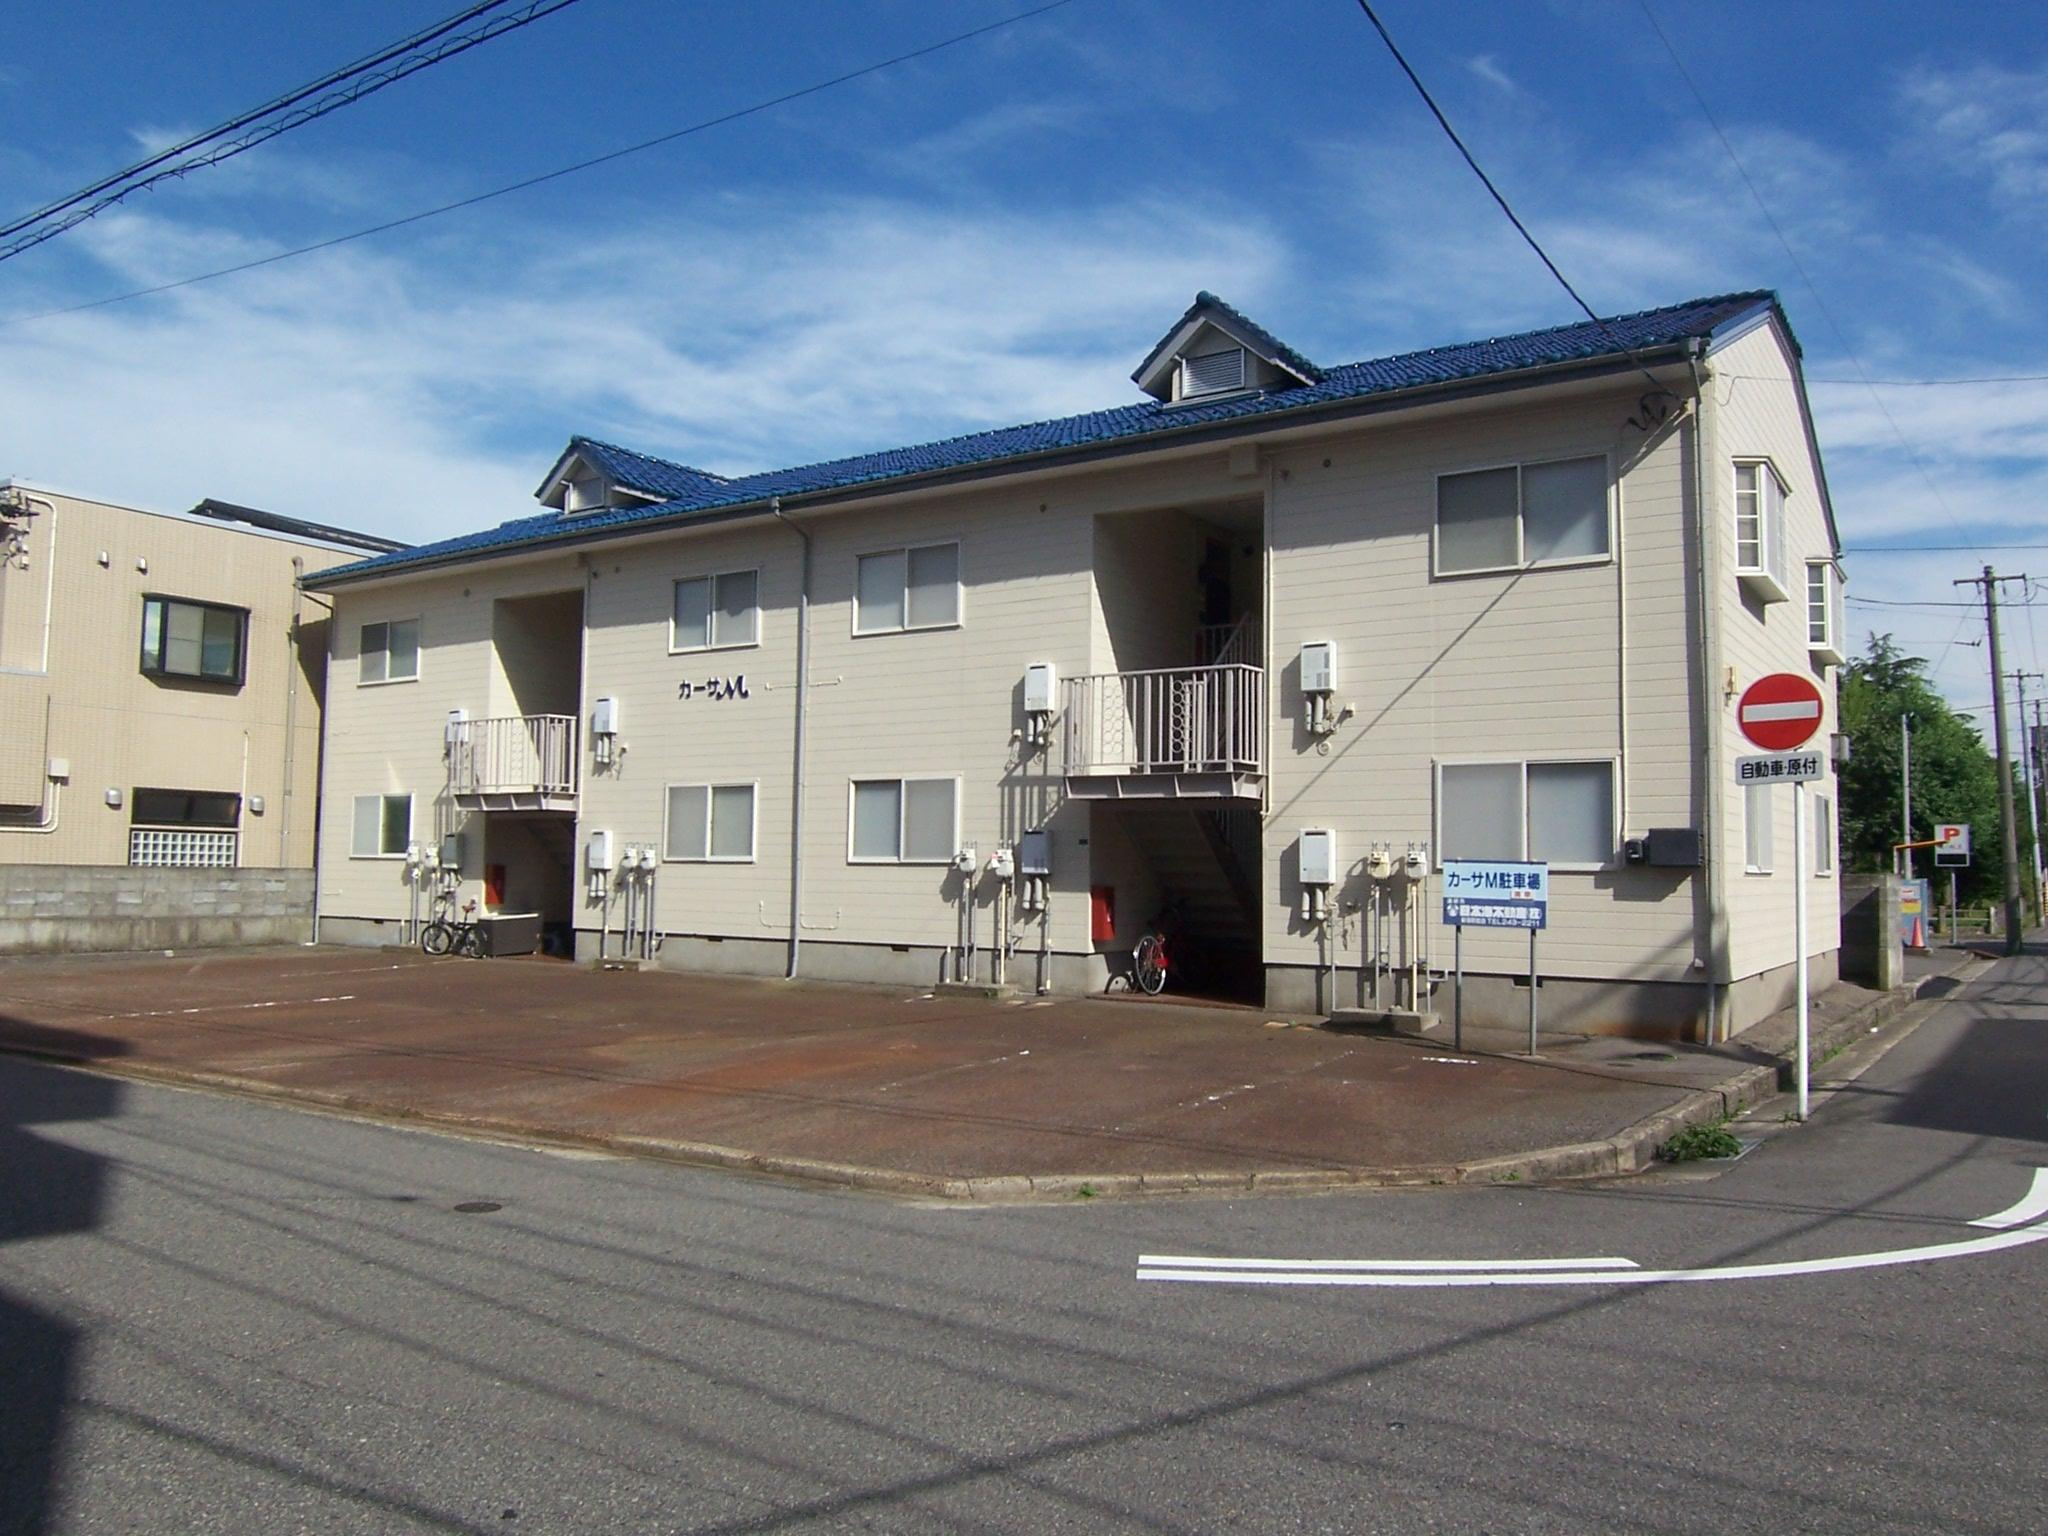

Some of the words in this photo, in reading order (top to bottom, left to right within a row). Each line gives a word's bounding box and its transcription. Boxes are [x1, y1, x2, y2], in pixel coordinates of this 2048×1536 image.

[679, 675, 749, 701] カーサM
[1943, 827, 1960, 841] P
[1448, 872, 1540, 889] カーサM駐車場
